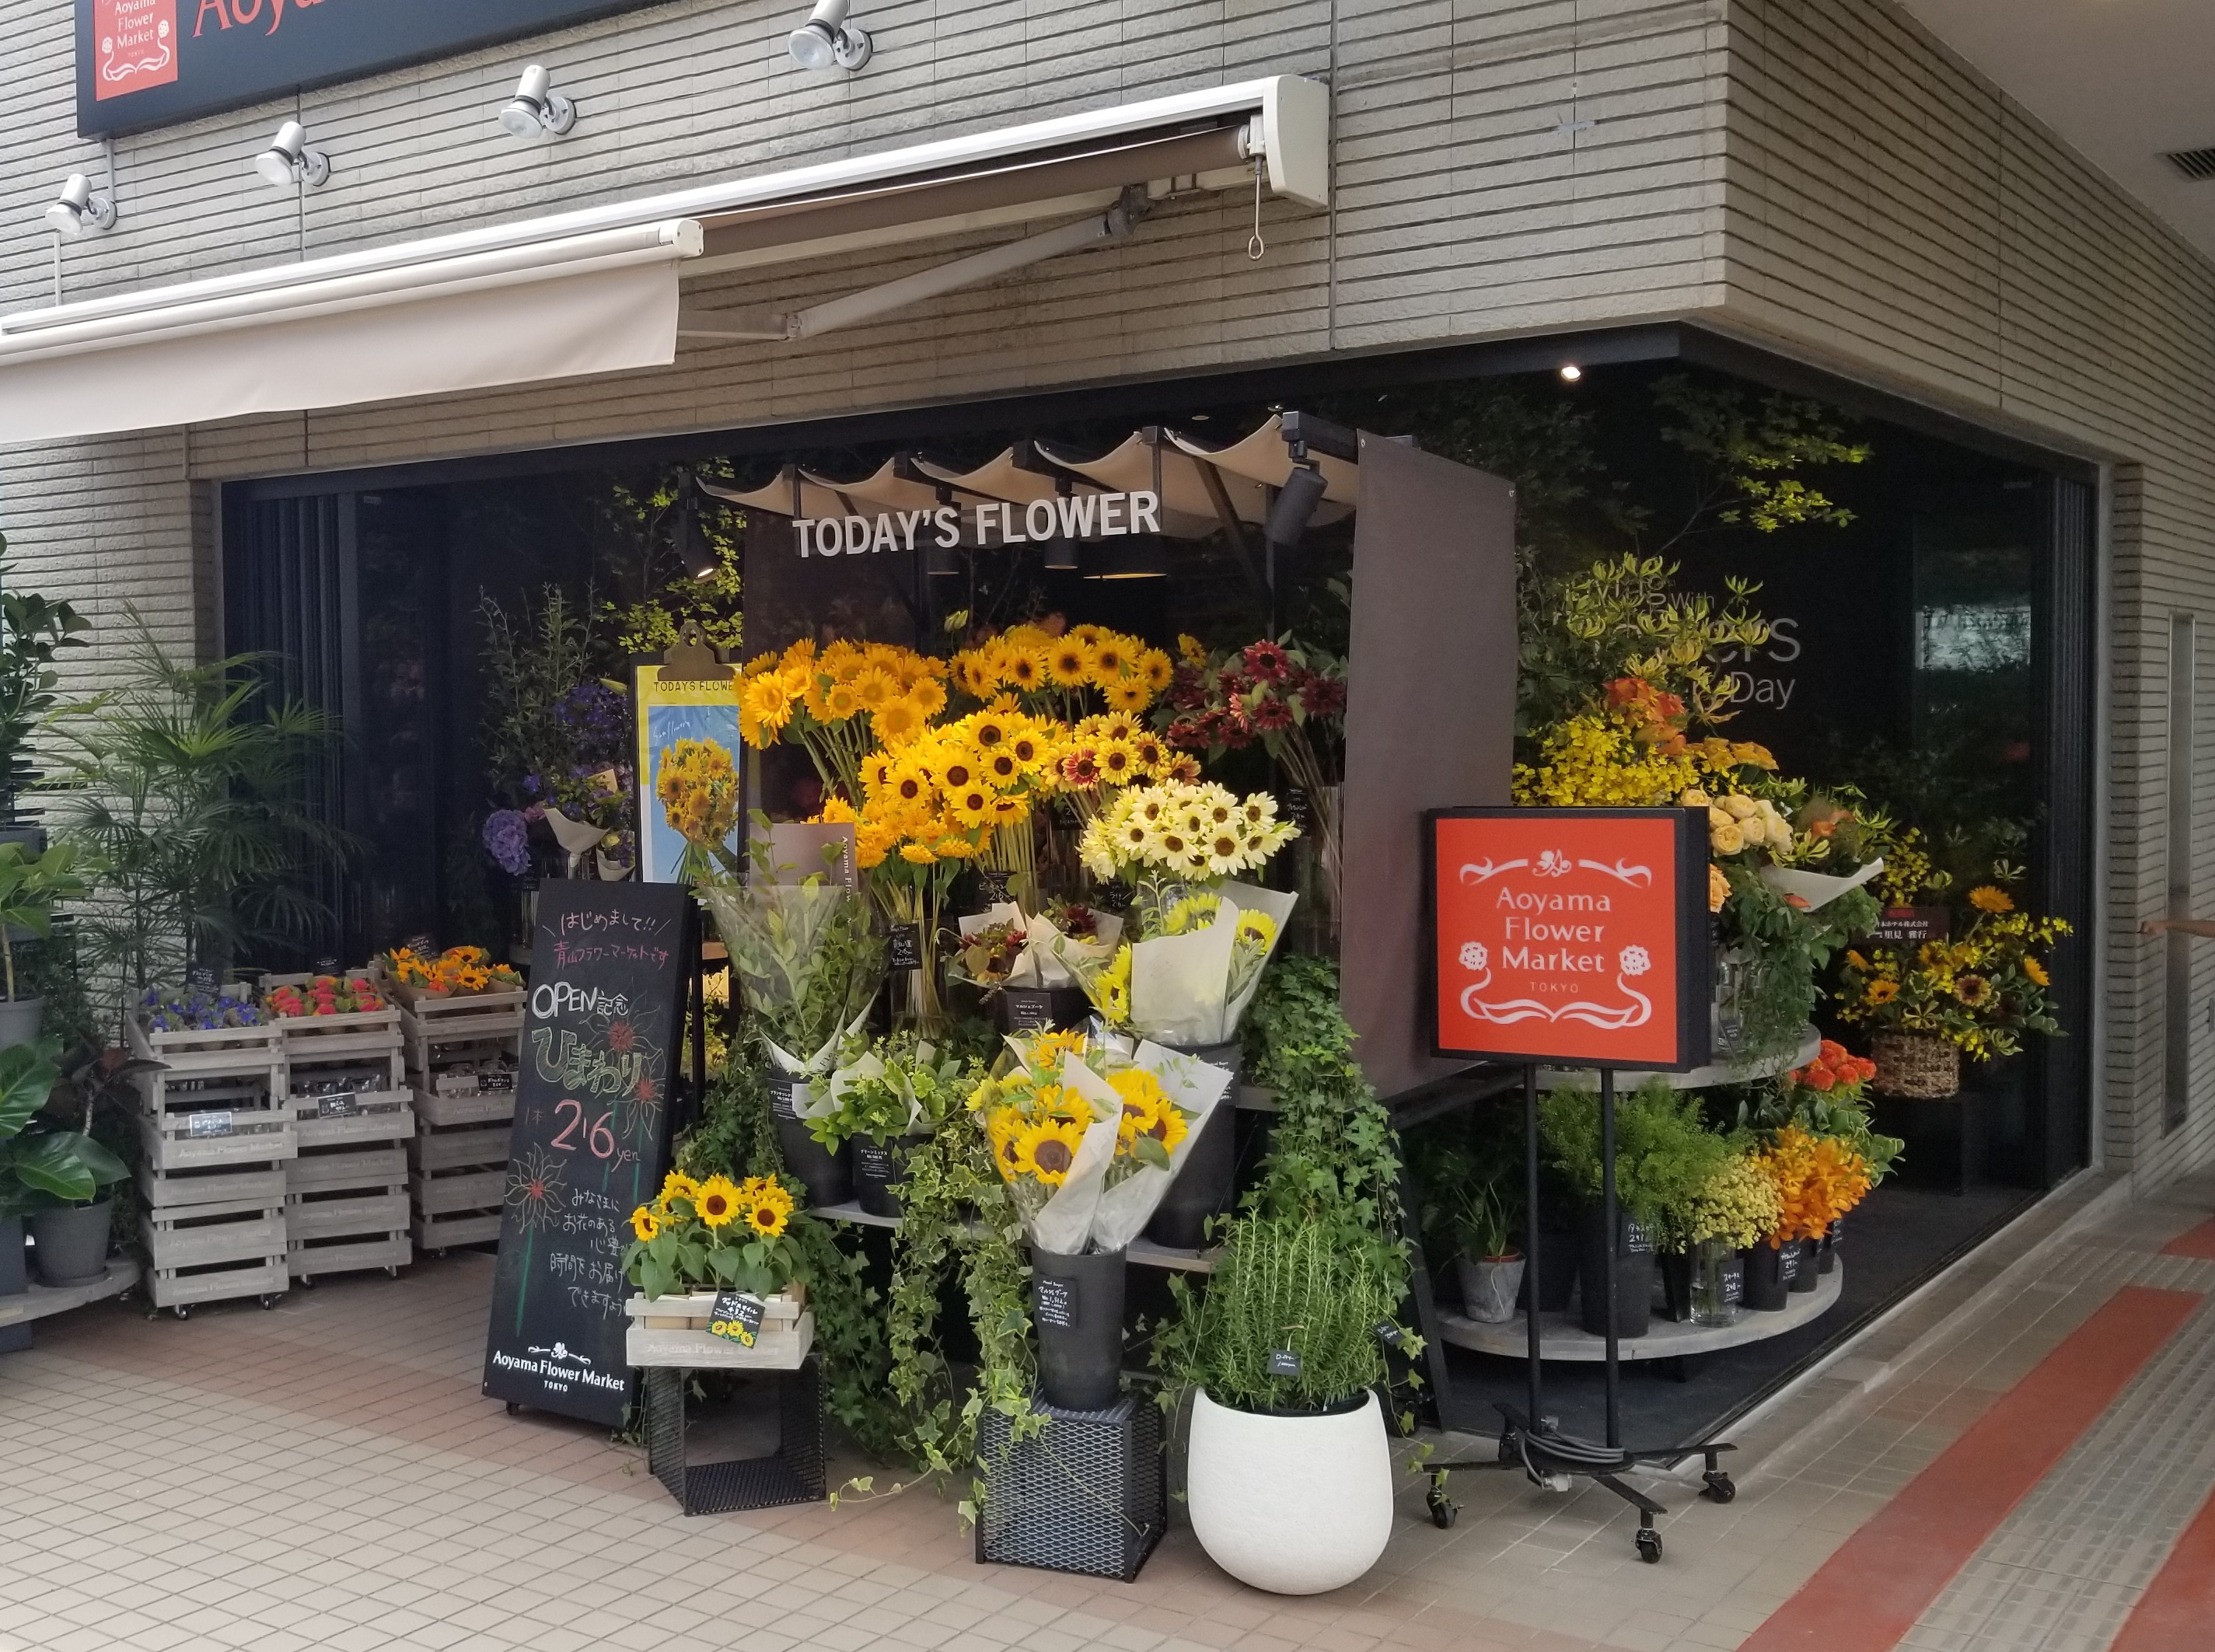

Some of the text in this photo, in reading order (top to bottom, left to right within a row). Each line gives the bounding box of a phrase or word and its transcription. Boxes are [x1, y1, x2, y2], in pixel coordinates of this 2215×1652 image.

[117, 12, 154, 32] Flower
[117, 29, 154, 49] Market
[792, 491, 1161, 558] TODAY'S FLOWER
[1730, 671, 1797, 710] Day
[1496, 886, 1612, 915] Aoyama
[1504, 917, 1605, 943] Flower
[1501, 946, 1605, 973] Market
[1529, 981, 1579, 994] TOKYO
[532, 1027, 642, 1097] ひまわり
[550, 1099, 615, 1158] 216
[611, 1147, 641, 1172] yen
[571, 1188, 620, 1213] みなさまに
[562, 1214, 616, 1238] お花のある
[568, 1286, 627, 1320] できますよう
[493, 1350, 625, 1392] Aoyama Flower Market
[543, 1379, 568, 1392] TOKYO
